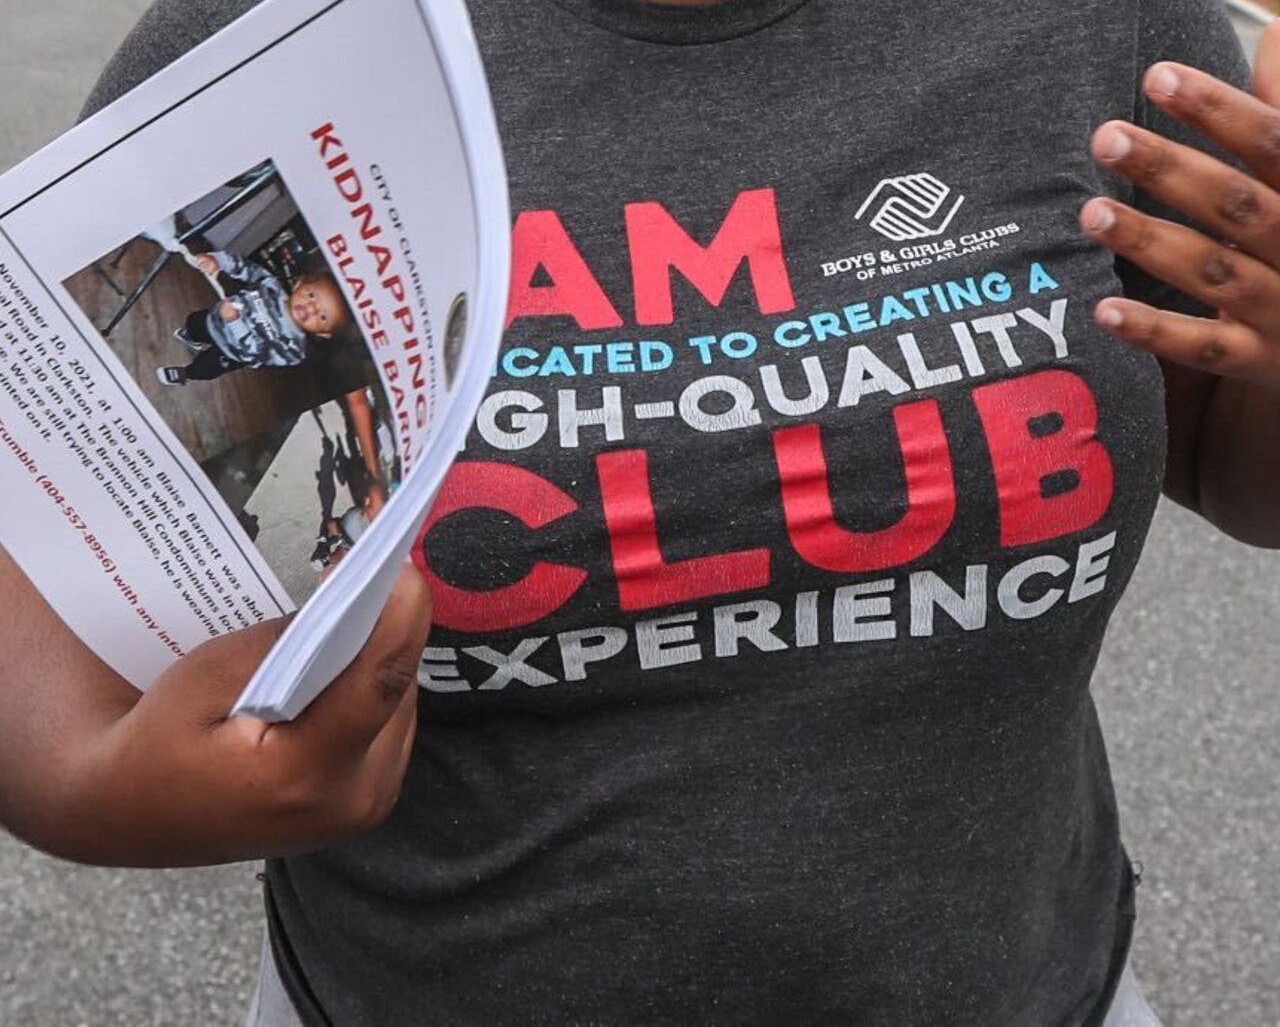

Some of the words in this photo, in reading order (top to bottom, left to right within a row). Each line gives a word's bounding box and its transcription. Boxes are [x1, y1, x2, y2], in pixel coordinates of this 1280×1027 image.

[309, 121, 427, 429] KIDNAPPING
[327, 233, 390, 352] BLAISE
[369, 163, 392, 202] CITY
[387, 207, 403, 233] OF
[399, 236, 433, 350] CLARKSTON
[504, 187, 797, 332] AM
[688, 331, 758, 365] TO
[773, 272, 1013, 349] CREATING
[1028, 262, 1060, 295] A
[821, 252, 877, 276] BOYS
[880, 249, 897, 264] &
[899, 239, 957, 260] GIRLS
[959, 222, 1021, 246] CLUBS
[856, 268, 877, 281] OF
[881, 258, 933, 276] METRO
[936, 239, 1001, 263] ATLANTA
[26, 411, 42, 429] on
[39, 428, 51, 442] it.
[458, 297, 1069, 452] GH-QUALITY
[4, 332, 19, 345] at
[18, 348, 48, 382] 11:30
[45, 385, 64, 405] am
[62, 408, 77, 420] at
[76, 422, 96, 445] The
[95, 446, 138, 498] Brannon
[137, 499, 158, 521] Hill
[154, 523, 220, 613] Condominiums
[218, 614, 234, 633] loc
[8, 308, 39, 342] Road
[34, 342, 47, 357] in
[46, 357, 93, 419] Clarkston.
[98, 424, 118, 446] The
[117, 448, 152, 490] vehicle
[151, 491, 180, 529] which
[178, 529, 207, 567] Blaise
[205, 568, 224, 594] was
[222, 595, 235, 608] in
[233, 609, 250, 629] wa
[10, 362, 29, 385] We
[26, 387, 46, 407] are
[44, 408, 67, 431] still
[62, 431, 94, 468] trying
[91, 466, 105, 481] to
[102, 480, 134, 518] locate
[132, 519, 161, 560] Blaise,
[160, 559, 175, 577] he
[172, 577, 183, 590] is
[181, 590, 219, 637] wearing
[49, 335, 67, 356] 10,
[67, 359, 96, 395] 2021,
[97, 399, 112, 412] at
[113, 417, 138, 444] 1:00
[136, 449, 155, 468] am
[155, 471, 186, 508] Blaise
[185, 512, 222, 560] Barnett
[221, 564, 241, 591] was
[410, 368, 1115, 635] CLUB
[35, 474, 117, 573] (404-557-8956)
[113, 574, 138, 606] with
[136, 607, 159, 630] any
[157, 630, 187, 658] infor
[417, 530, 1118, 694] EXPERIENCE
